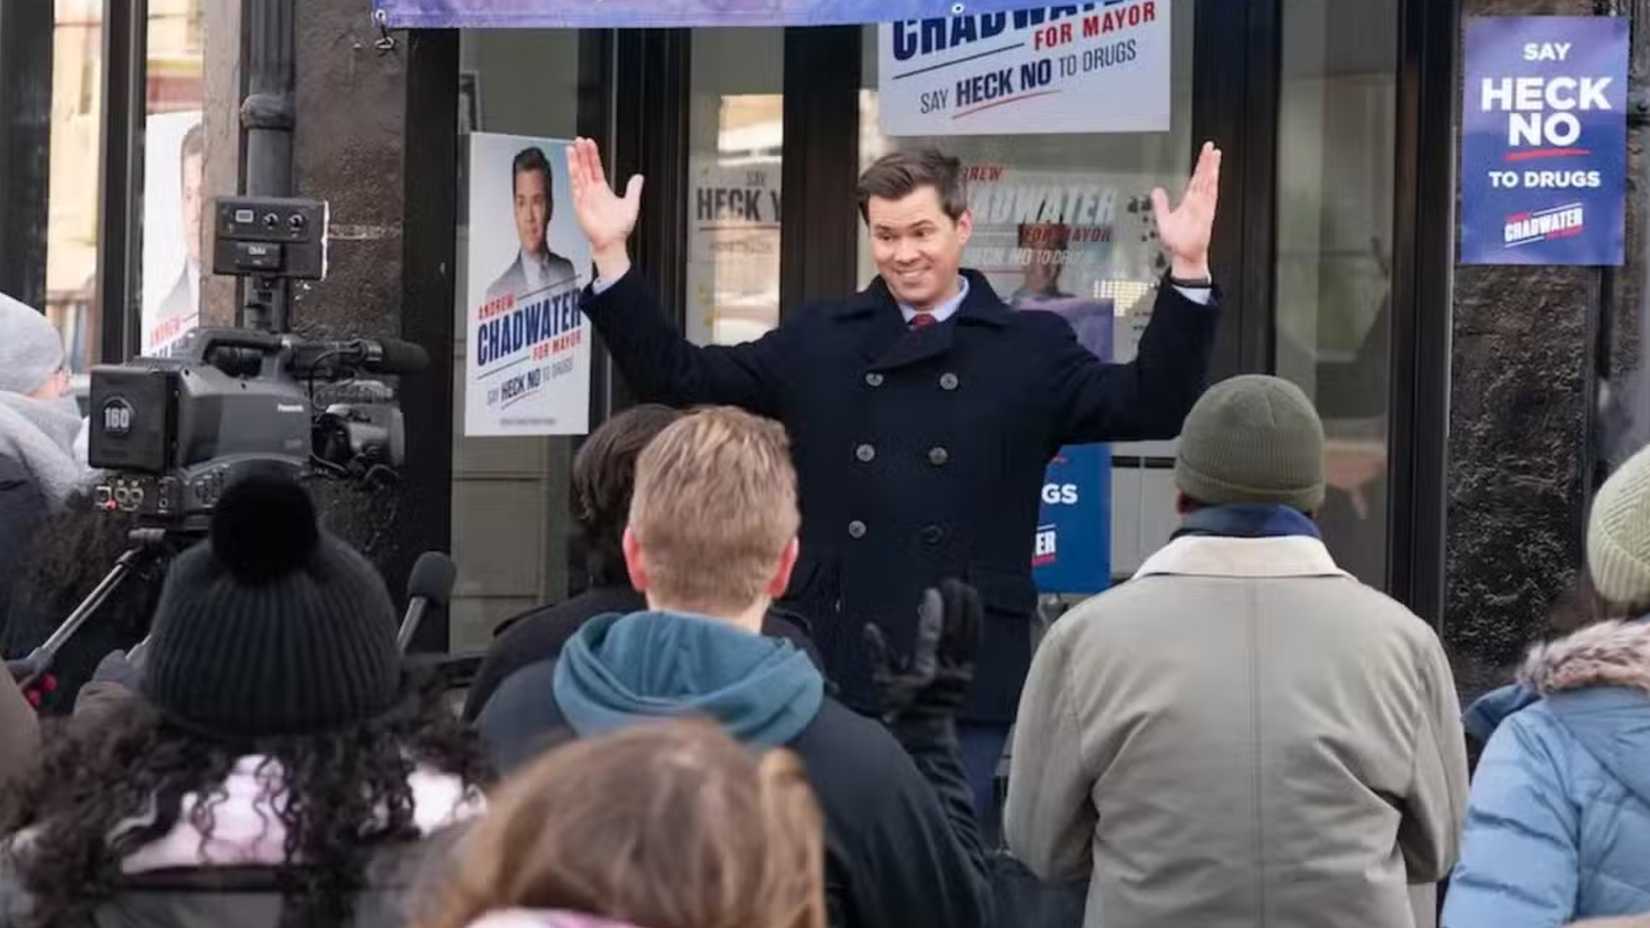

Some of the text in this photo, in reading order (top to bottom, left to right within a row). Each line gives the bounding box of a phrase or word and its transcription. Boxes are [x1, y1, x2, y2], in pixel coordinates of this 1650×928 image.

[1034, 2, 1156, 50] FOR MAYOR
[1523, 43, 1571, 60] SAY
[920, 39, 1137, 114] SAY HECK NO TO DRUGS
[1481, 77, 1612, 111] HECK
[1508, 112, 1581, 146] NO
[1488, 171, 1601, 188] TO DRUGS
[697, 187, 761, 221] HECK
[478, 288, 581, 367] CHADWATER
[501, 374, 526, 401] HECK
